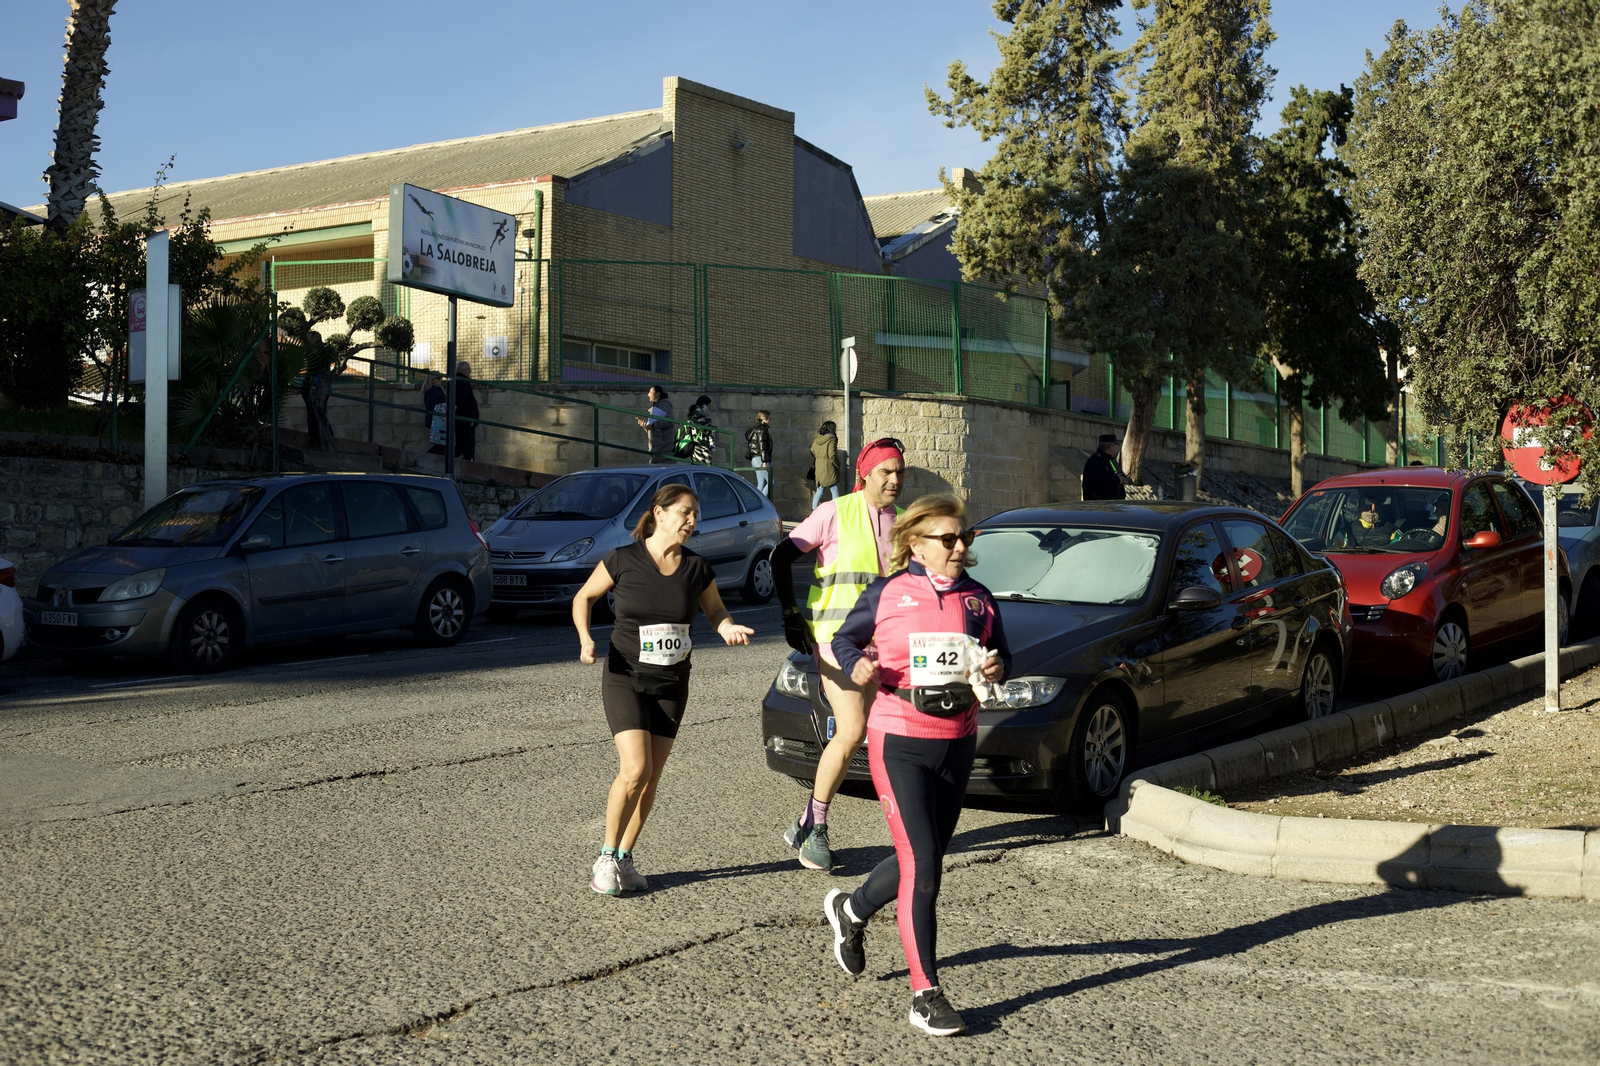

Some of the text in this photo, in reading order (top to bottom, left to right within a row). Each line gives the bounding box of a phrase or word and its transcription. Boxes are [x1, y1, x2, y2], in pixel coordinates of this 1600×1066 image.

[420, 238, 497, 274] LA SALOBREJA
[509, 575, 524, 584] BTX
[43, 612, 61, 624] 4350
[656, 638, 681, 650] 100
[912, 637, 926, 648] XXV
[936, 651, 959, 666] 42
